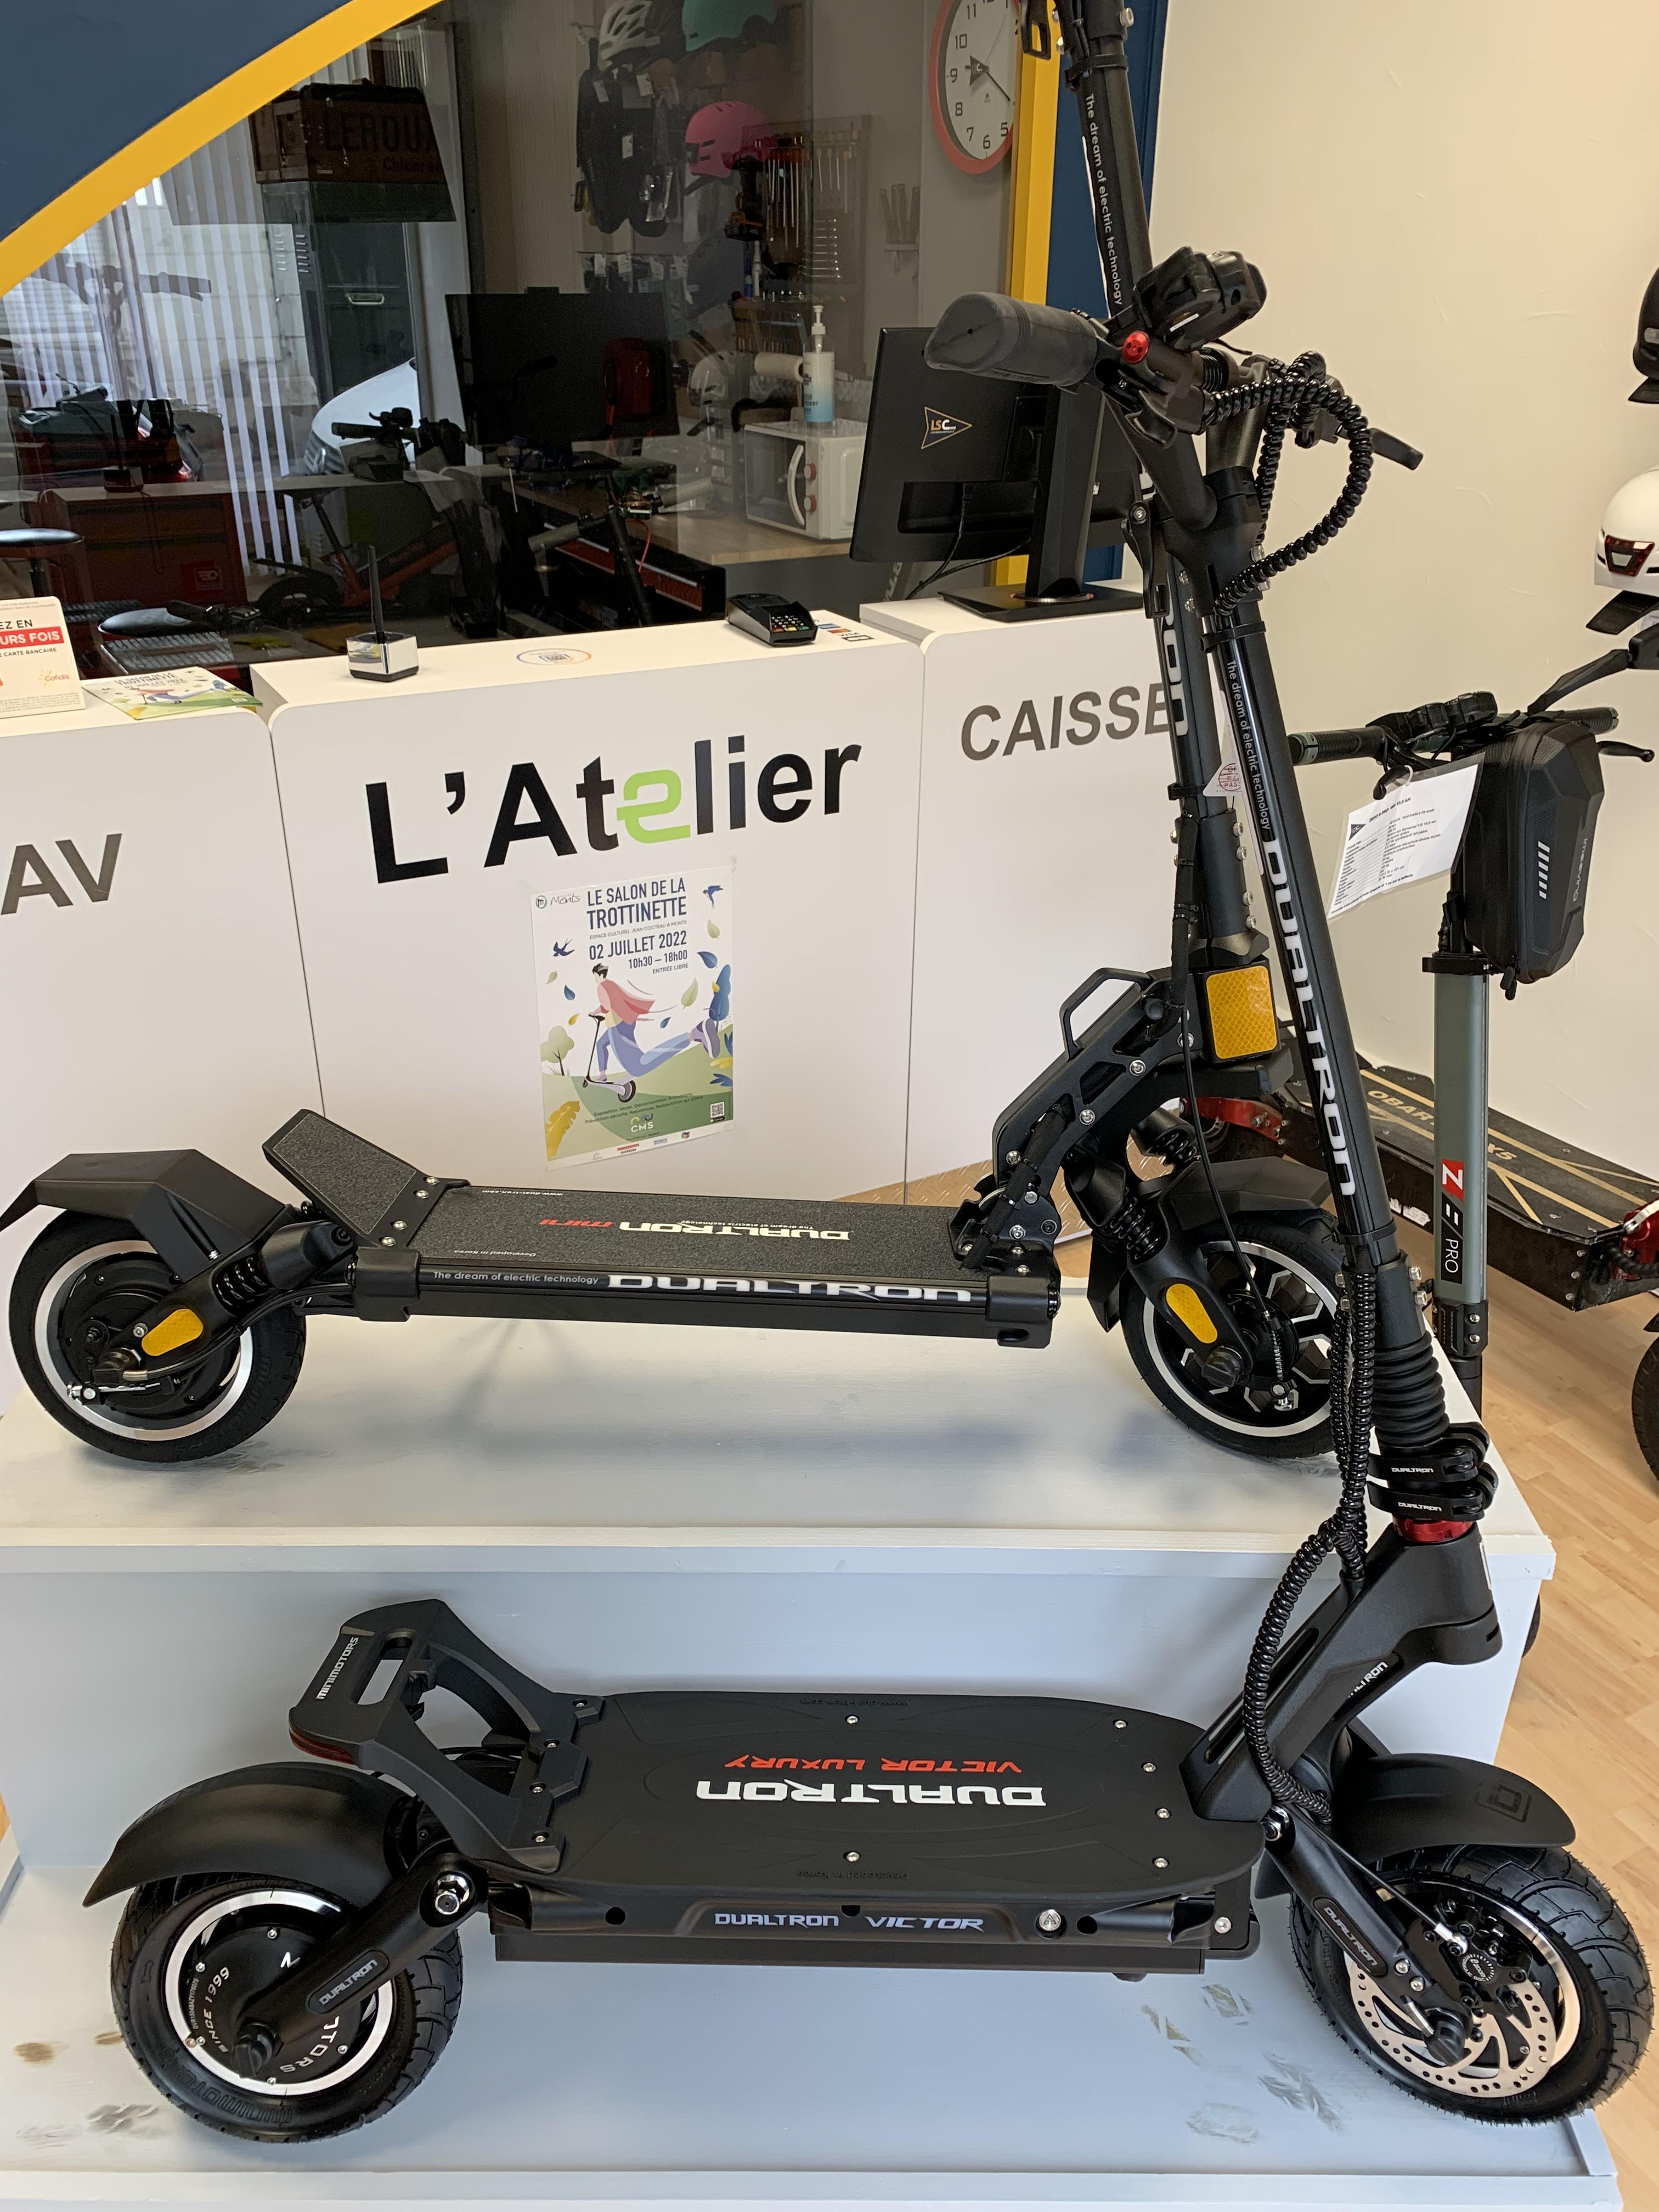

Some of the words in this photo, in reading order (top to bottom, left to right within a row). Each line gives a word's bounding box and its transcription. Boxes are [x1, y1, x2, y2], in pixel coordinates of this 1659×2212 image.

[966, 3, 977, 20] 11
[955, 33, 968, 50] 10
[950, 67, 958, 83] 9
[955, 101, 963, 116] 8
[1085, 93, 1095, 118] The
[966, 126, 974, 142] 7
[1000, 121, 1009, 137] 5
[983, 134, 991, 150] 6
[1090, 122, 1103, 167] dream
[1097, 170, 1107, 183] of
[1098, 184, 1113, 234] electric
[1105, 236, 1123, 306] technology
[17, 619, 33, 628] EN
[29, 631, 60, 642] FOIS
[1226, 659, 1237, 680] The
[1232, 681, 1245, 718] dream
[1240, 718, 1250, 731] of
[1243, 731, 1258, 771] electric
[1252, 772, 1271, 831] technology
[1, 832, 122, 916] AV
[588, 888, 603, 907] LE
[606, 882, 647, 904] SALON
[651, 880, 667, 897] DE
[670, 877, 686, 894] LA
[586, 896, 687, 930] TROTTINETTE
[607, 929, 631, 938] CULTUREL
[644, 923, 667, 932] COCTEAU
[670, 919, 687, 928] MONTS
[589, 944, 604, 961] 02
[607, 935, 655, 957] JUILLET
[658, 930, 687, 949] 2022
[628, 955, 653, 969] 10h30
[664, 950, 688, 964] 18h00
[652, 964, 673, 974] ENTRÉE
[1263, 837, 1356, 1197] DUALTRON
[1368, 1090, 1435, 1126] OBAR
[631, 1121, 654, 1133] CMS
[619, 1221, 850, 1240] DUALTRON
[1444, 1238, 1459, 1274] PRO
[433, 1271, 452, 1279] The
[454, 1272, 488, 1280] dream
[490, 1273, 501, 1281] of
[503, 1273, 541, 1282] electric
[543, 1274, 600, 1285] technology
[607, 1273, 972, 1302] DUALTRON
[1398, 1502, 1442, 1512] DUALTRON
[315, 1637, 359, 1700] MINIMOTORS
[724, 1754, 866, 1770] LUXURY
[881, 1757, 1022, 1774] VICTOR
[696, 1779, 1047, 1807] DUALTRON
[714, 1912, 839, 1928] DUALTRON
[865, 1916, 985, 1933] VICTOR
[1323, 1906, 1378, 1968] DUALTRON
[205, 1966, 230, 2004] 1999
[319, 1959, 379, 2006] DUALTRON
